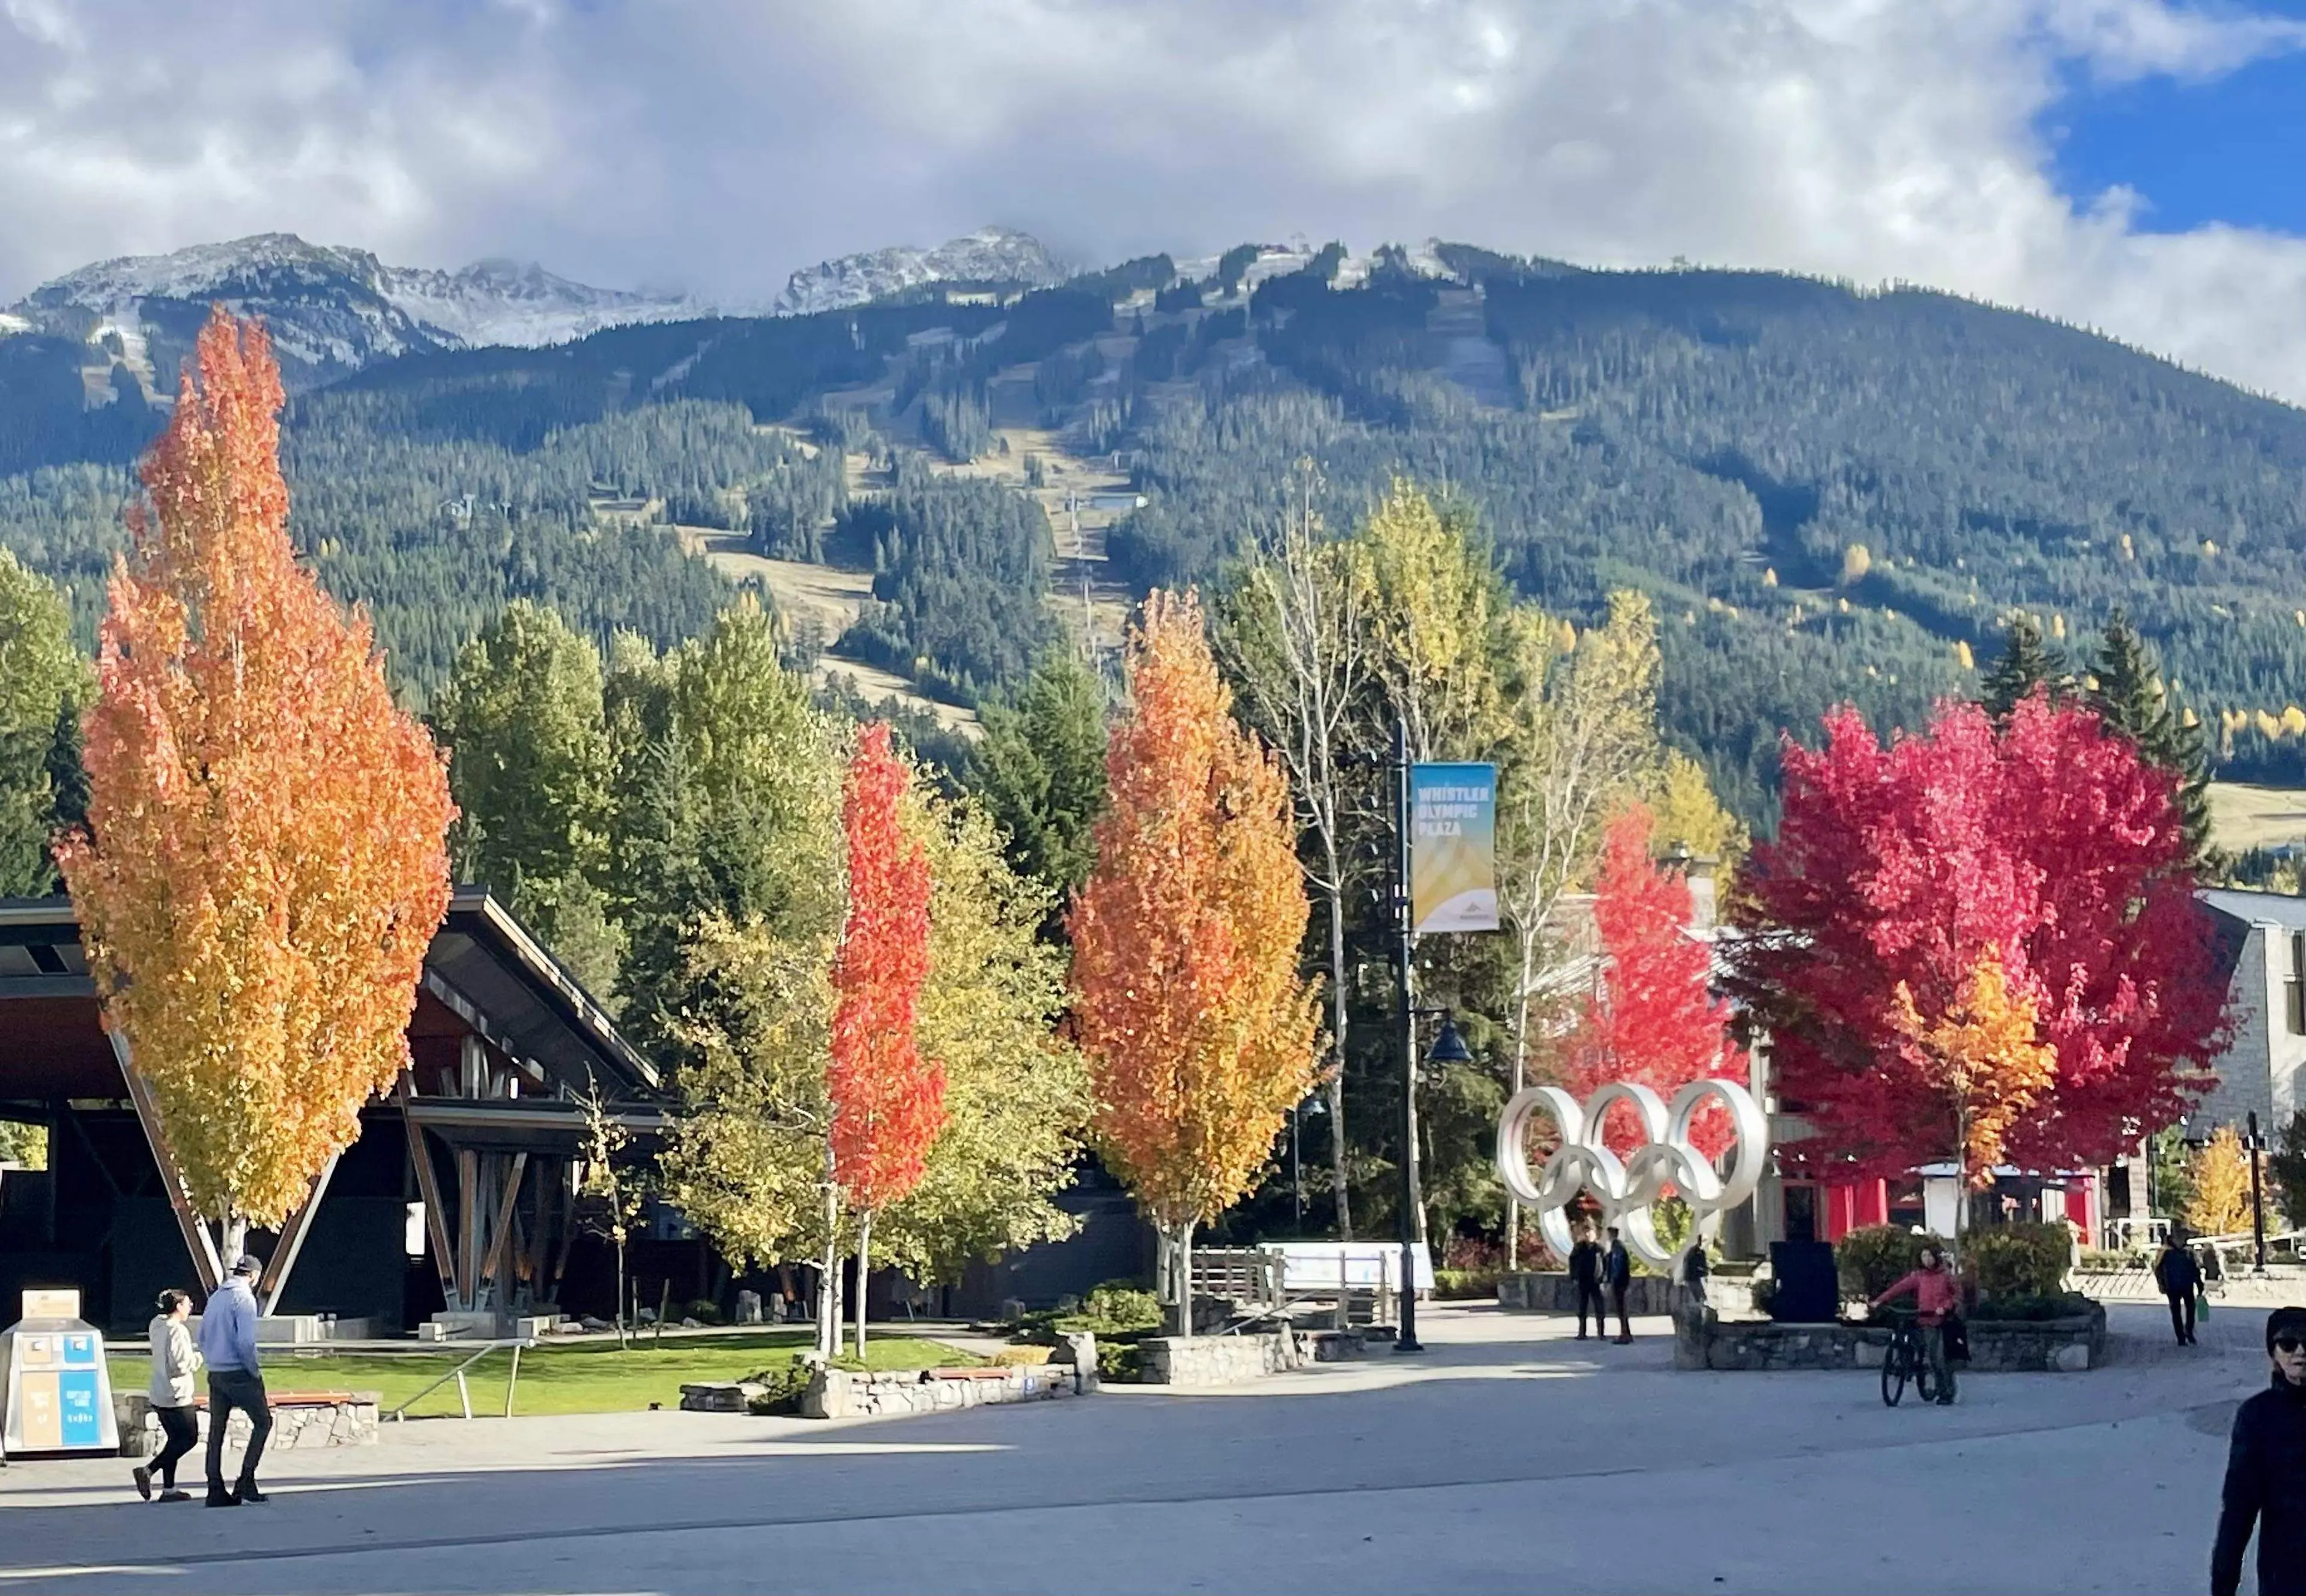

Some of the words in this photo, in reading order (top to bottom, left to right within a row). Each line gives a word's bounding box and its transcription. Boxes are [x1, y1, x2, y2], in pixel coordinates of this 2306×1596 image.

[1418, 787, 1489, 802] WHISTLER
[1418, 804, 1477, 818] OLYMPIC
[1418, 821, 1460, 836] PLAZA
